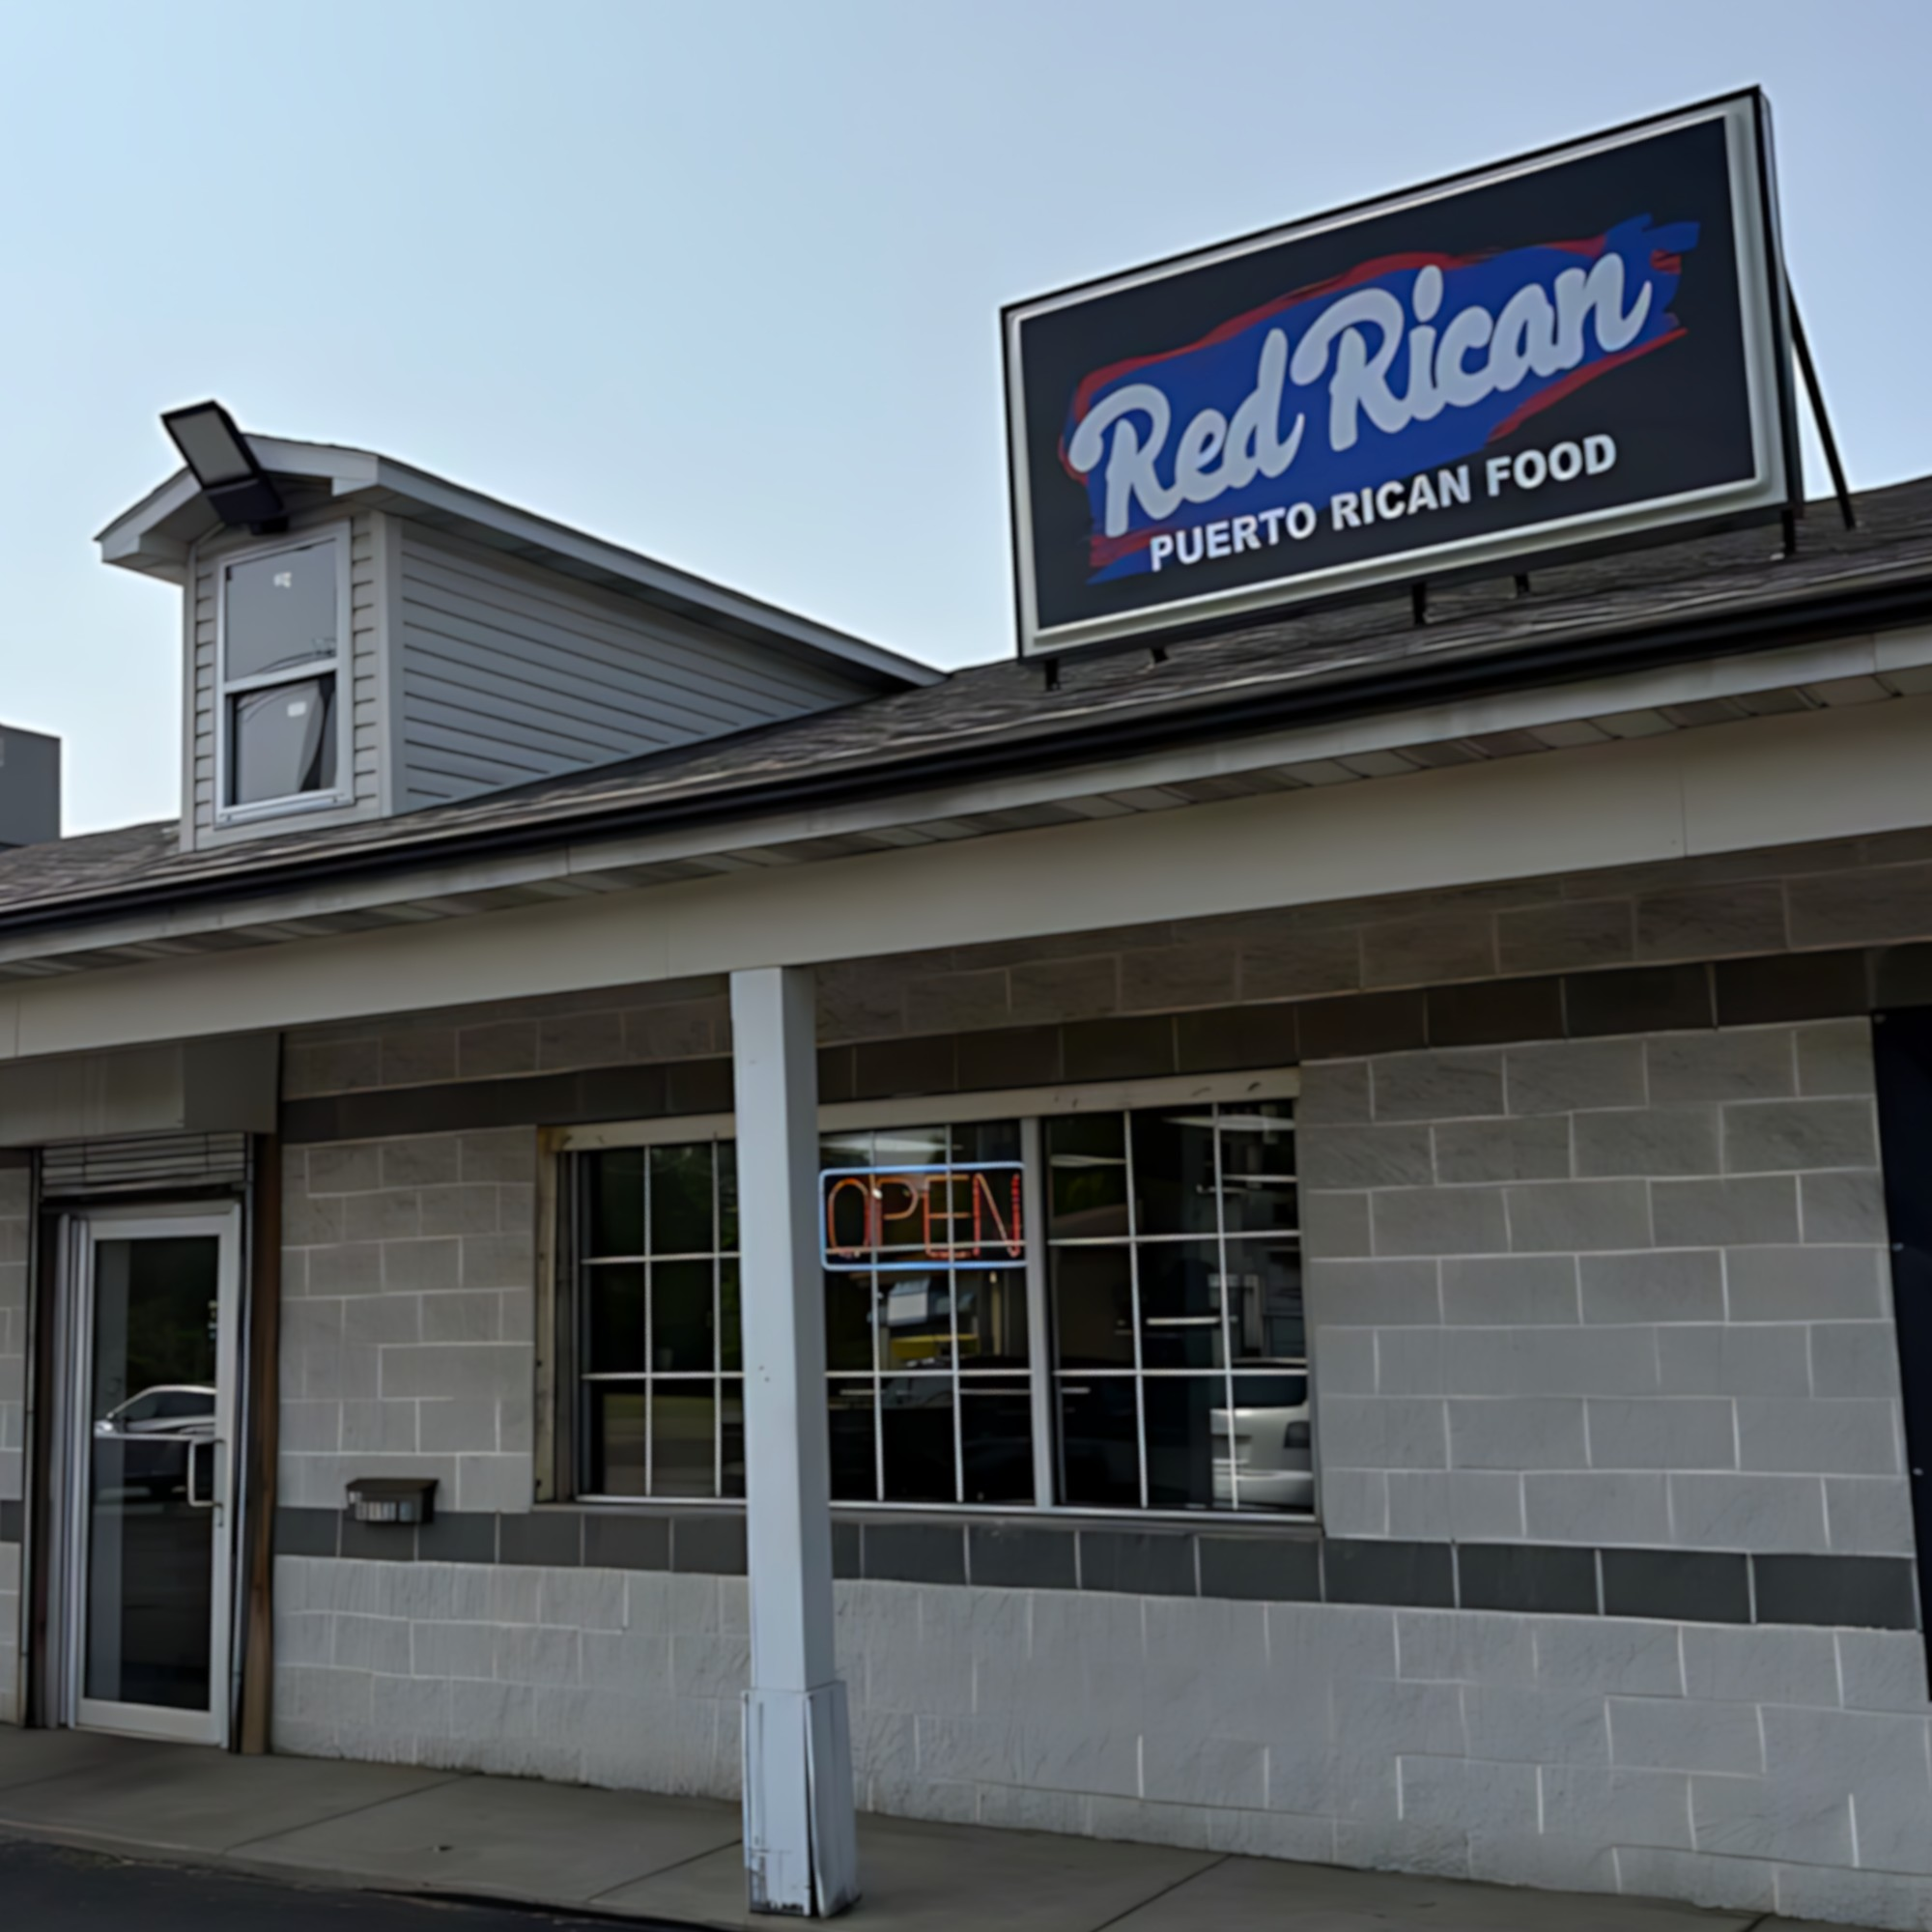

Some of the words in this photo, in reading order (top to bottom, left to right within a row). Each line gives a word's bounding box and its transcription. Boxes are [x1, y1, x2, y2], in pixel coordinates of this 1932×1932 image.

[1068, 328, 1305, 537] Red
[1292, 252, 1652, 451] Rican
[1150, 503, 1317, 572] PUERTO
[1332, 466, 1470, 531] RICAN
[1487, 434, 1617, 497] FOOD
[828, 1173, 1020, 1258] OPEN
